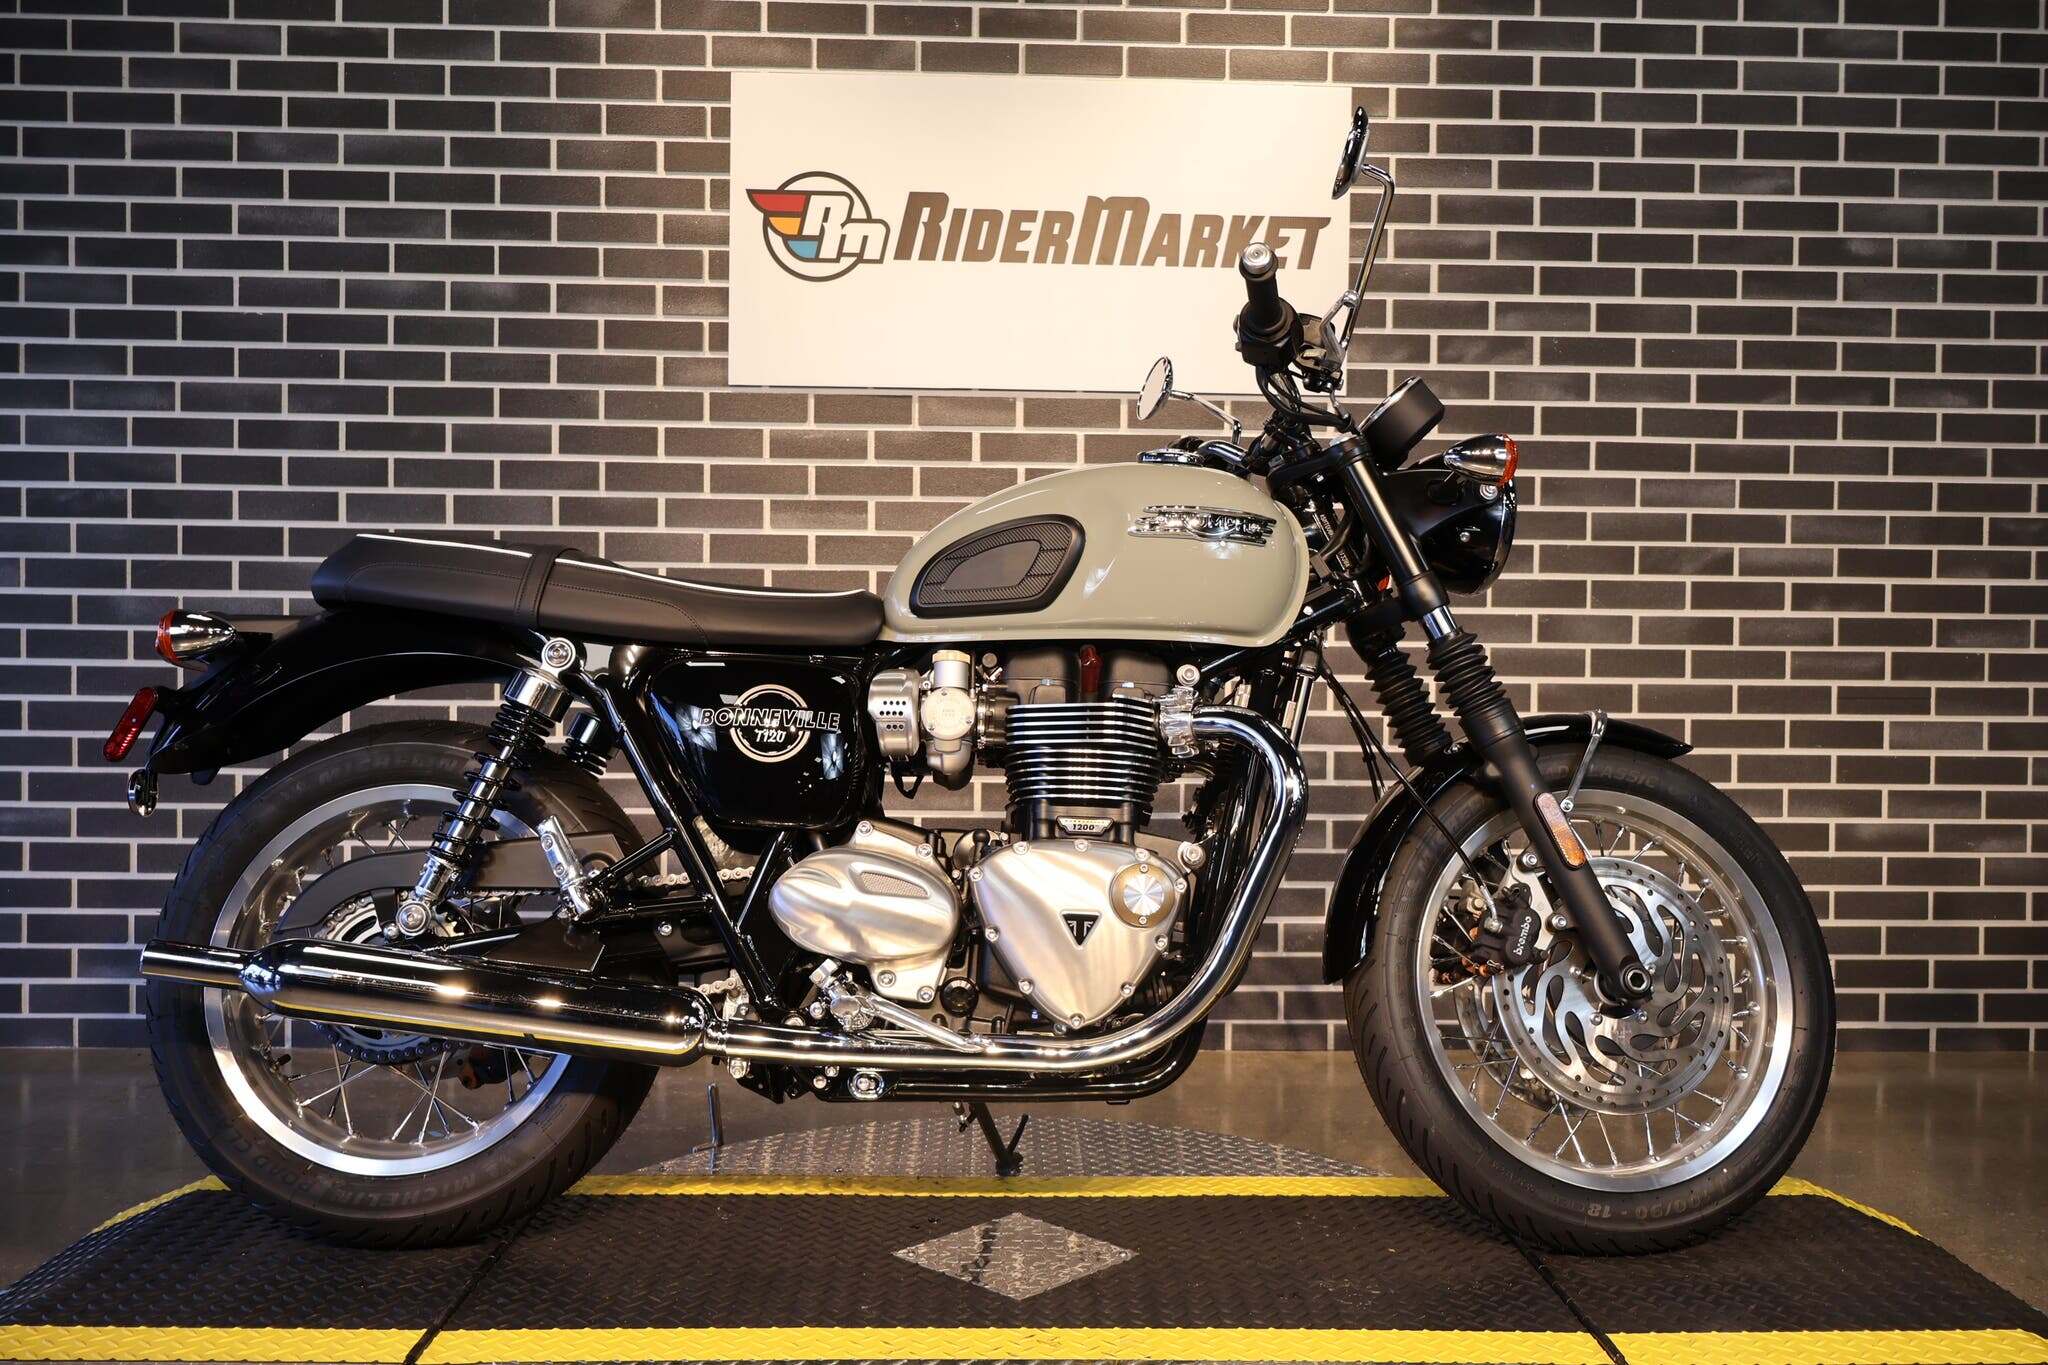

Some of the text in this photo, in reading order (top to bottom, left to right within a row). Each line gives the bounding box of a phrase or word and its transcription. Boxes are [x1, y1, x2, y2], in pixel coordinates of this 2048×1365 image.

[700, 708, 840, 730] BONNEVILLE
[755, 728, 785, 742] T120
[1073, 823, 1095, 831] 1200
[1512, 915, 1533, 956] brembo
